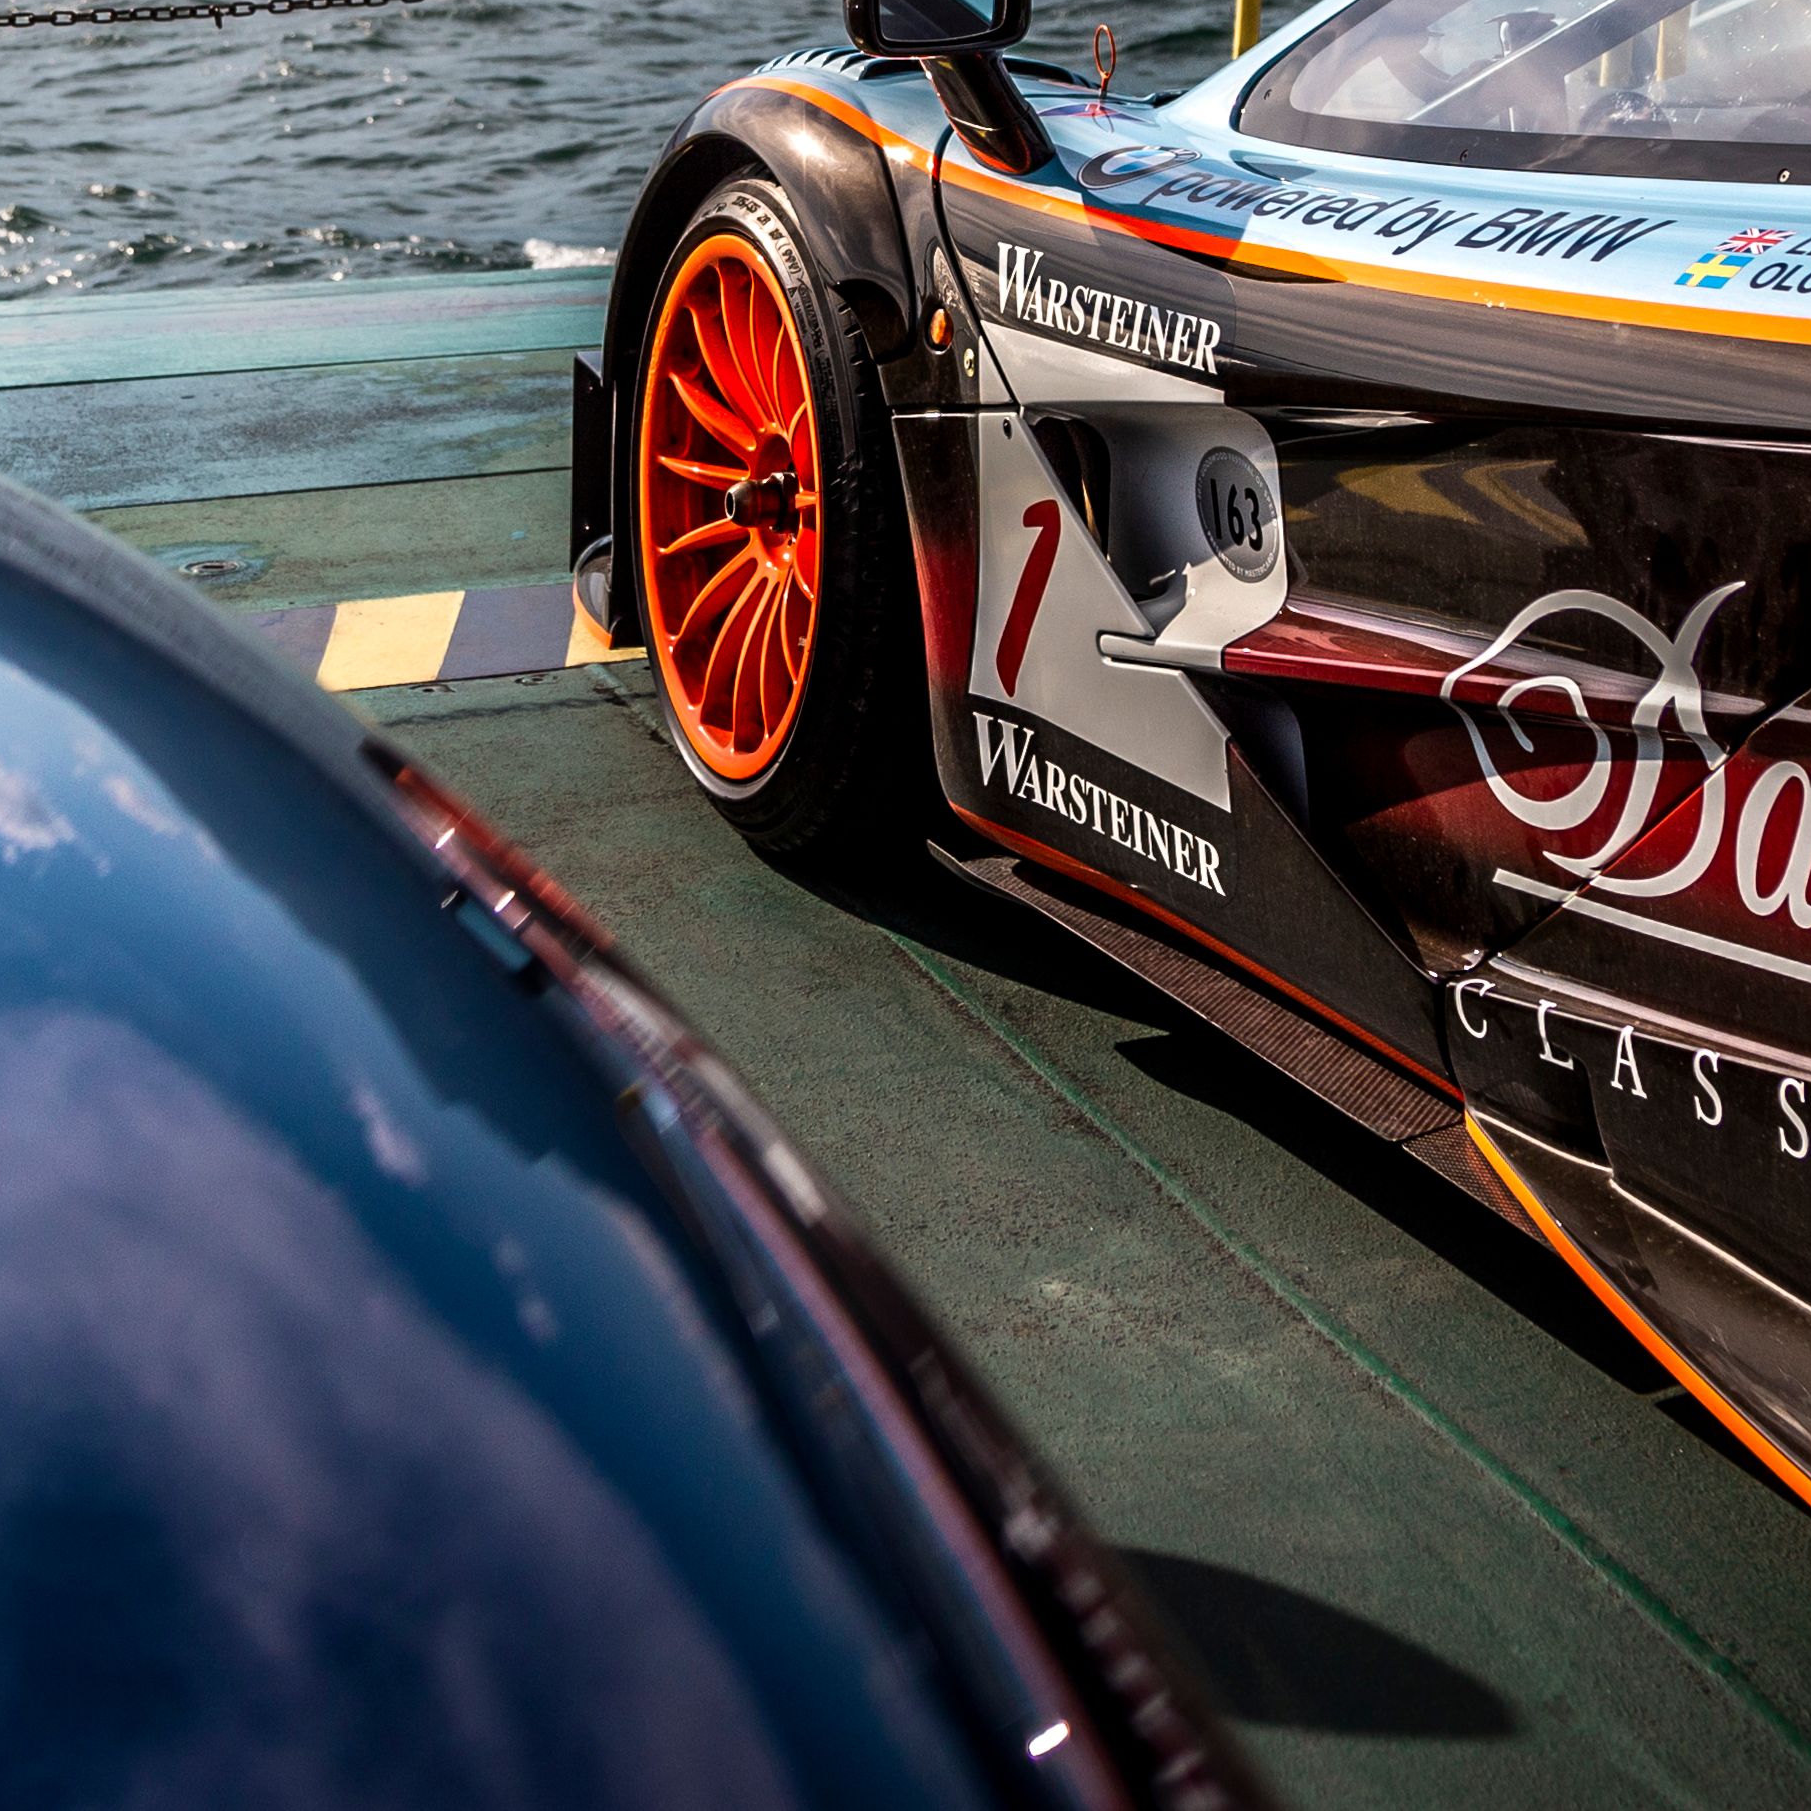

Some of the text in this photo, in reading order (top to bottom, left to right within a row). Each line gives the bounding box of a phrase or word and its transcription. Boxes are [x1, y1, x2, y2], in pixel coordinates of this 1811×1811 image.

[1139, 171, 1677, 263] powered by BMW
[997, 241, 1222, 375] WARSTEINER
[1210, 478, 1263, 552] 163
[996, 498, 1062, 698] 1
[973, 711, 1226, 897] WARSTEINER
